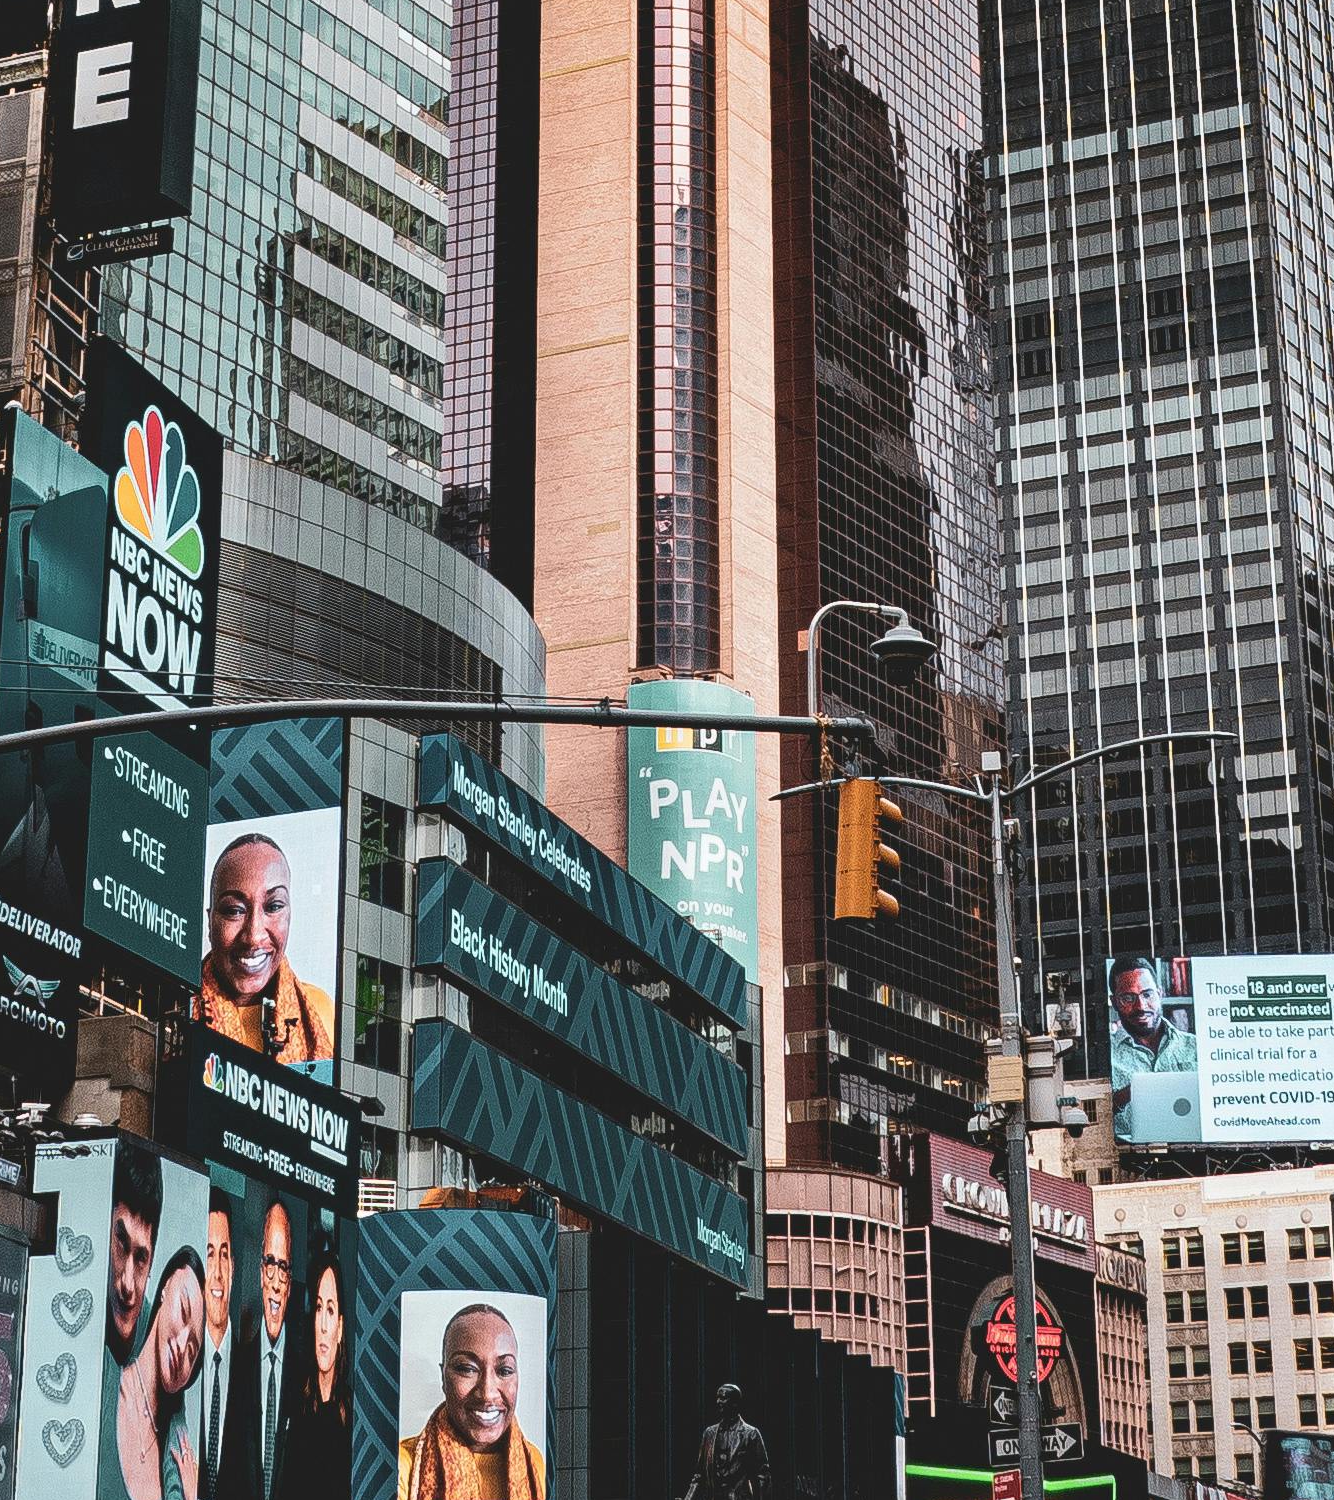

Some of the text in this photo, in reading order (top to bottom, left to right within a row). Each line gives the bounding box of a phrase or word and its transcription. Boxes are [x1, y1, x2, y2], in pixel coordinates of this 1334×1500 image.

[111, 526, 203, 619] NBC NEWS
[105, 570, 202, 700] NOW
[114, 747, 190, 818] STREAMING
[452, 759, 591, 892] Morgan Stanley Celebrates
[132, 828, 166, 875] FREE
[0, 902, 81, 959] DELIVERATOR
[102, 880, 188, 950] EVERYWHERE
[677, 900, 734, 918] on your
[450, 907, 568, 1016] Black History Month
[1206, 981, 1245, 995] Those
[1249, 981, 1265, 995] 18
[1267, 981, 1293, 995] and
[1296, 983, 1325, 995] over
[1207, 1006, 1228, 1016] are
[1231, 1004, 1255, 1016] not
[1257, 1002, 1330, 1016] vaccinated
[1209, 1025, 1225, 1038] be
[1228, 1025, 1256, 1038] able
[1258, 1027, 1272, 1038] to
[1275, 1024, 1305, 1037] take
[1307, 1026, 1334, 1040] part
[1210, 1047, 1317, 1060] clinical trial for a
[1211, 1070, 1266, 1086] possible
[1213, 1093, 1266, 1108] prevent
[223, 1059, 348, 1151] NBC NEWS NOW
[1213, 1115, 1321, 1127] CovidMoveAhead.com
[222, 1131, 335, 1195] STREAMING FREE EVERYWHERE
[696, 1216, 745, 1269] Morgan Stanley
[1041, 1436, 1067, 1452] WAY
